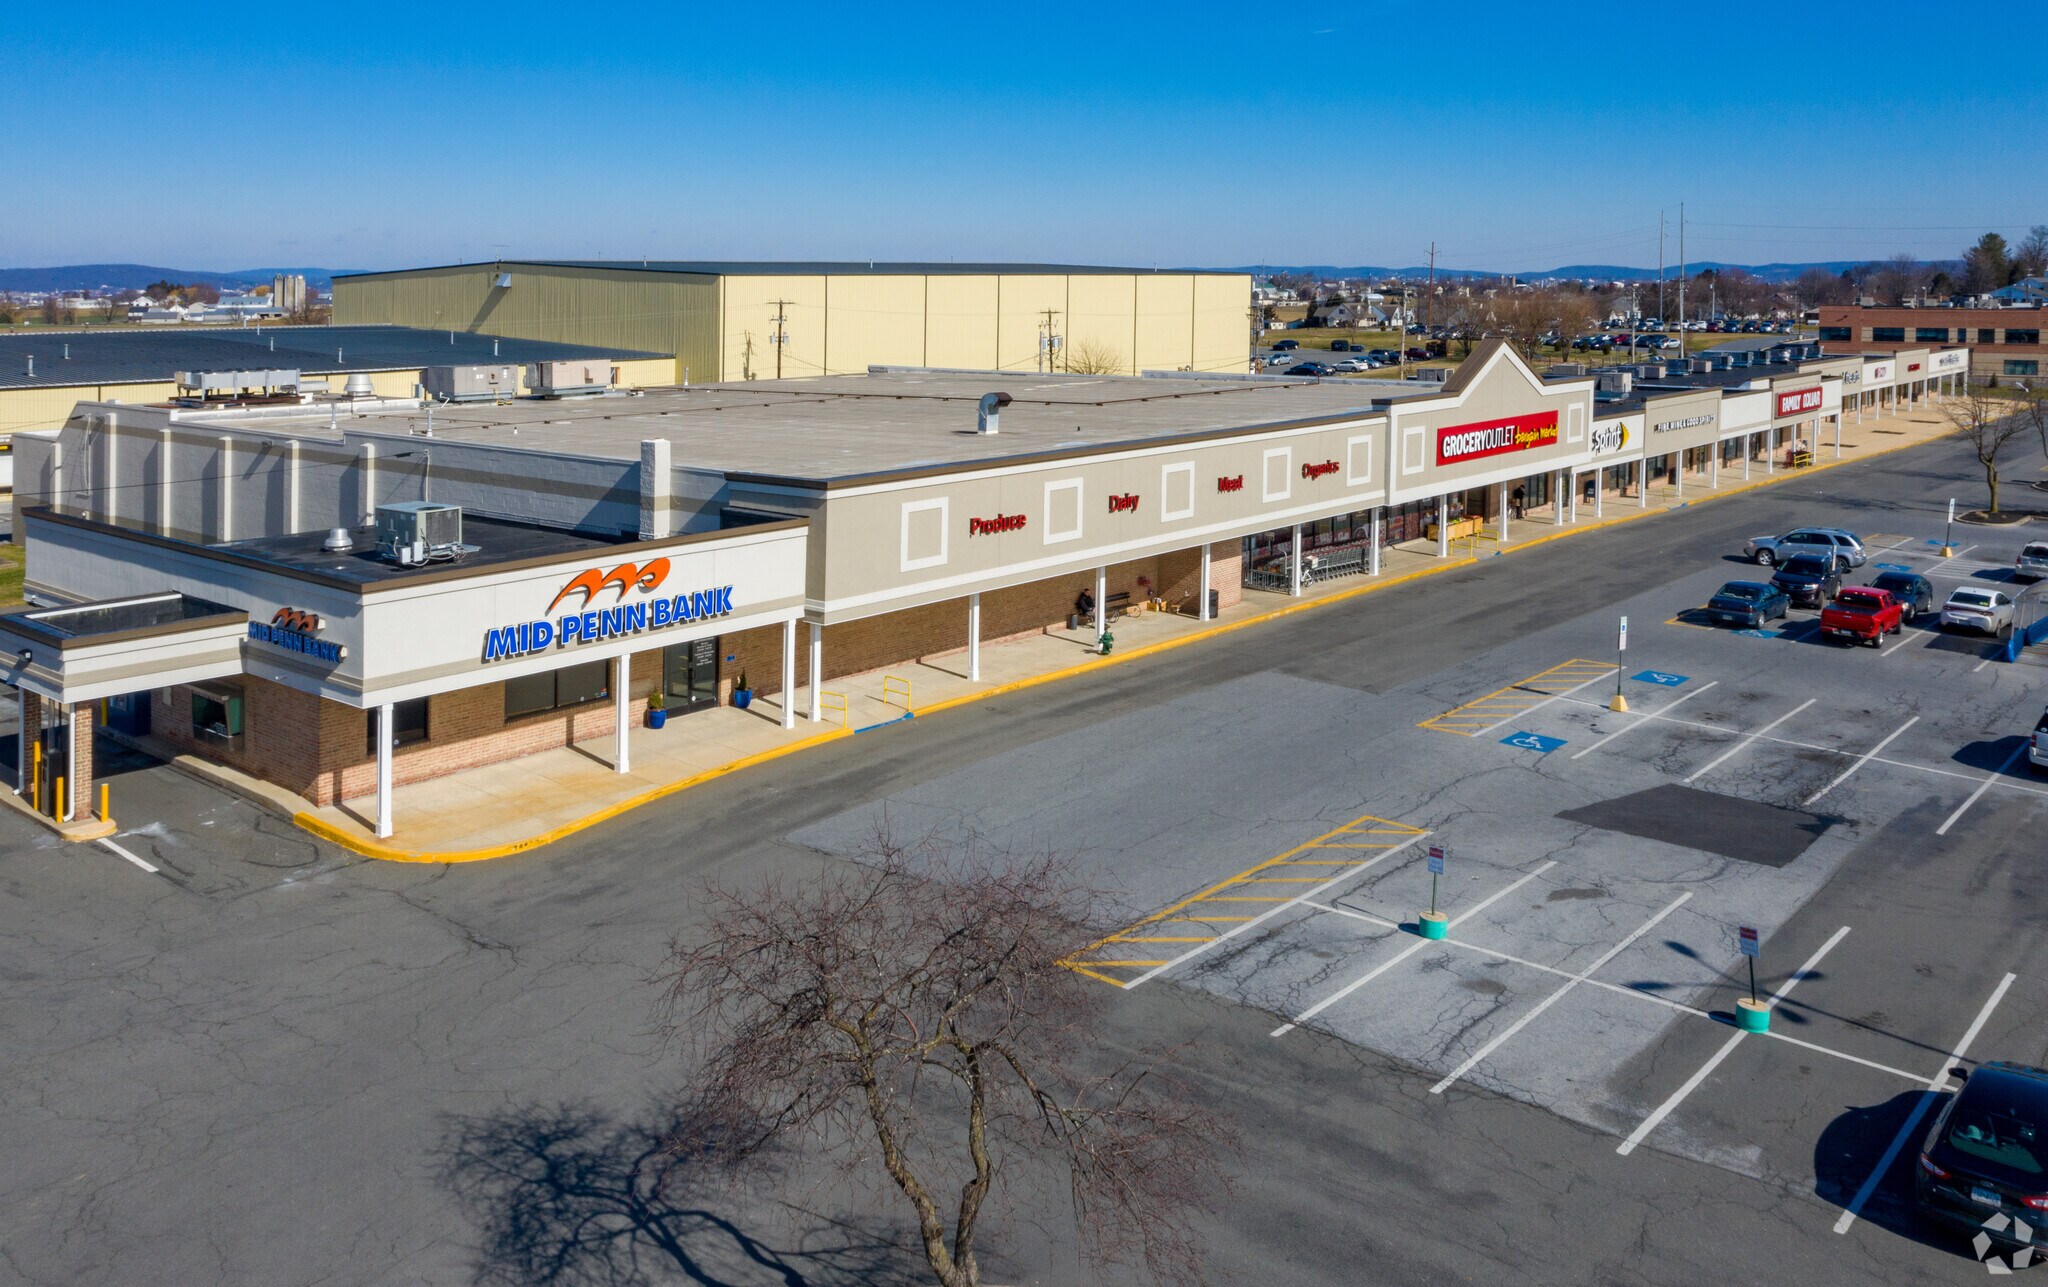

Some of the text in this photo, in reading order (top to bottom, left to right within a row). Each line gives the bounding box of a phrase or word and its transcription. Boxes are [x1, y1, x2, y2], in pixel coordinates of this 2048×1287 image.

[1782, 390, 1821, 413] FAMILY DOLLAR
[1514, 425, 1540, 449] bargain
[1540, 422, 1559, 440] market
[1594, 422, 1622, 451] Sprint
[1302, 460, 1340, 481] Organics
[1218, 474, 1244, 493] Meat
[1109, 493, 1141, 514] Dairy
[970, 513, 1027, 537] Produce
[485, 585, 734, 661] MID PENN BANK
[248, 620, 343, 664] MID PENN BANK
